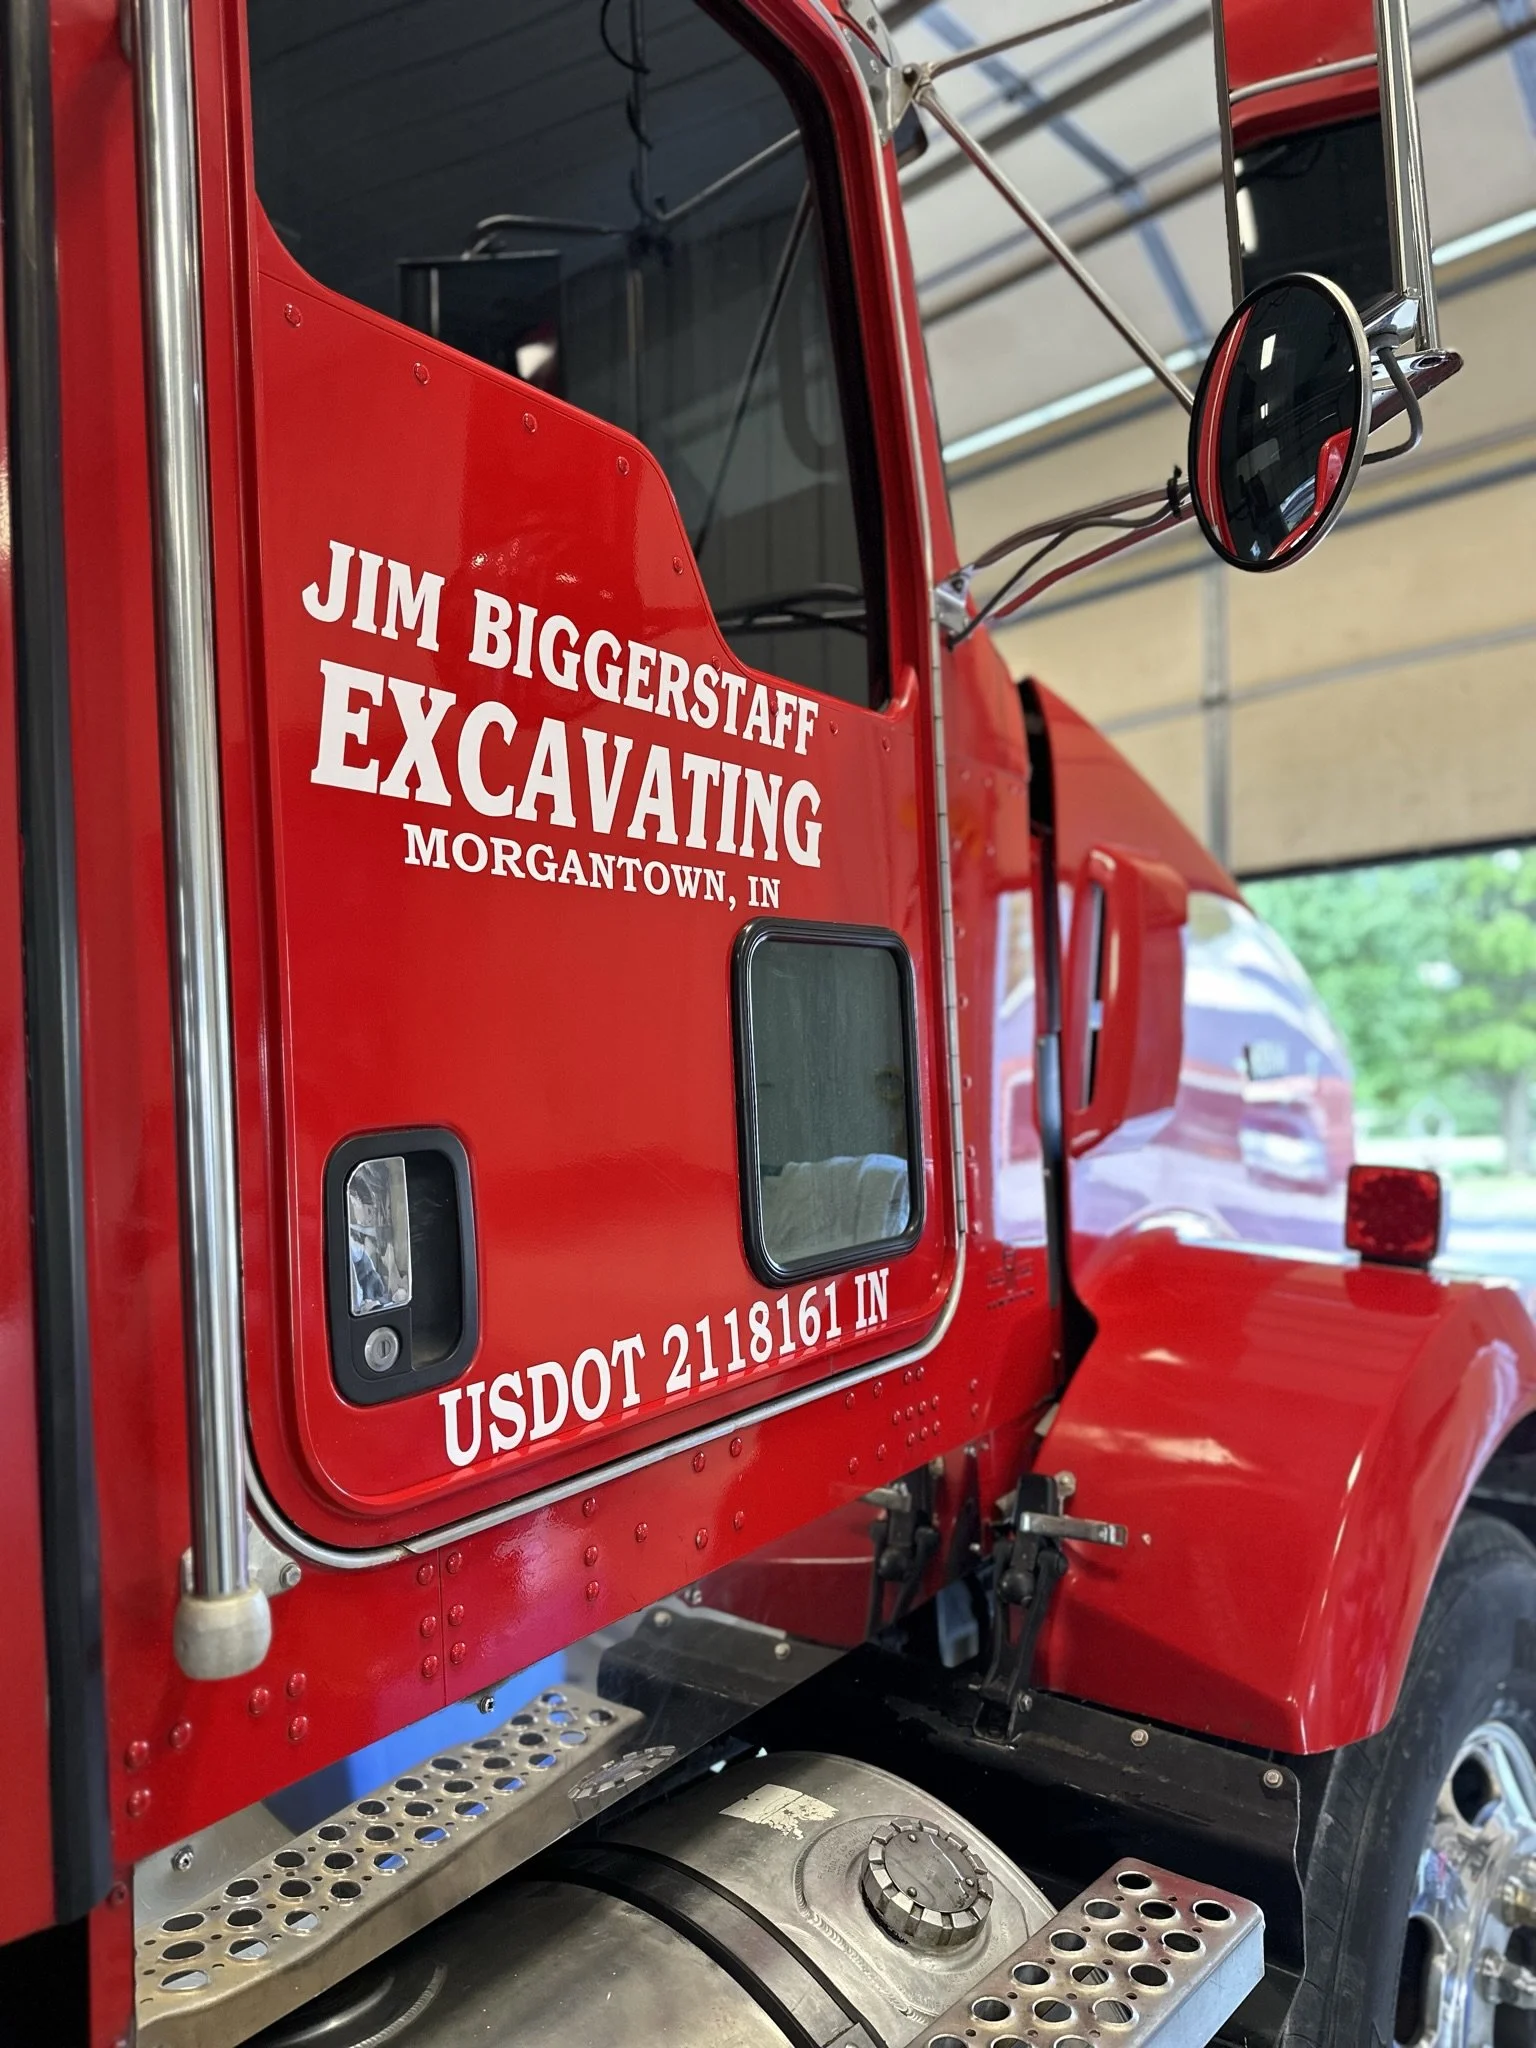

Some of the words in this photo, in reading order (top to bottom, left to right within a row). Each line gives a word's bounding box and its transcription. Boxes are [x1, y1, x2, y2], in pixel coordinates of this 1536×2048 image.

[302, 539, 446, 652] JIM
[468, 588, 819, 756] BIGGERSTAFF
[310, 659, 823, 868] EXCAVATING
[402, 823, 737, 912] MORGANTOWN,
[748, 875, 781, 909] IN
[438, 1333, 646, 1467] USDOT
[662, 1280, 842, 1395] 2118161
[854, 1267, 889, 1330] IN
